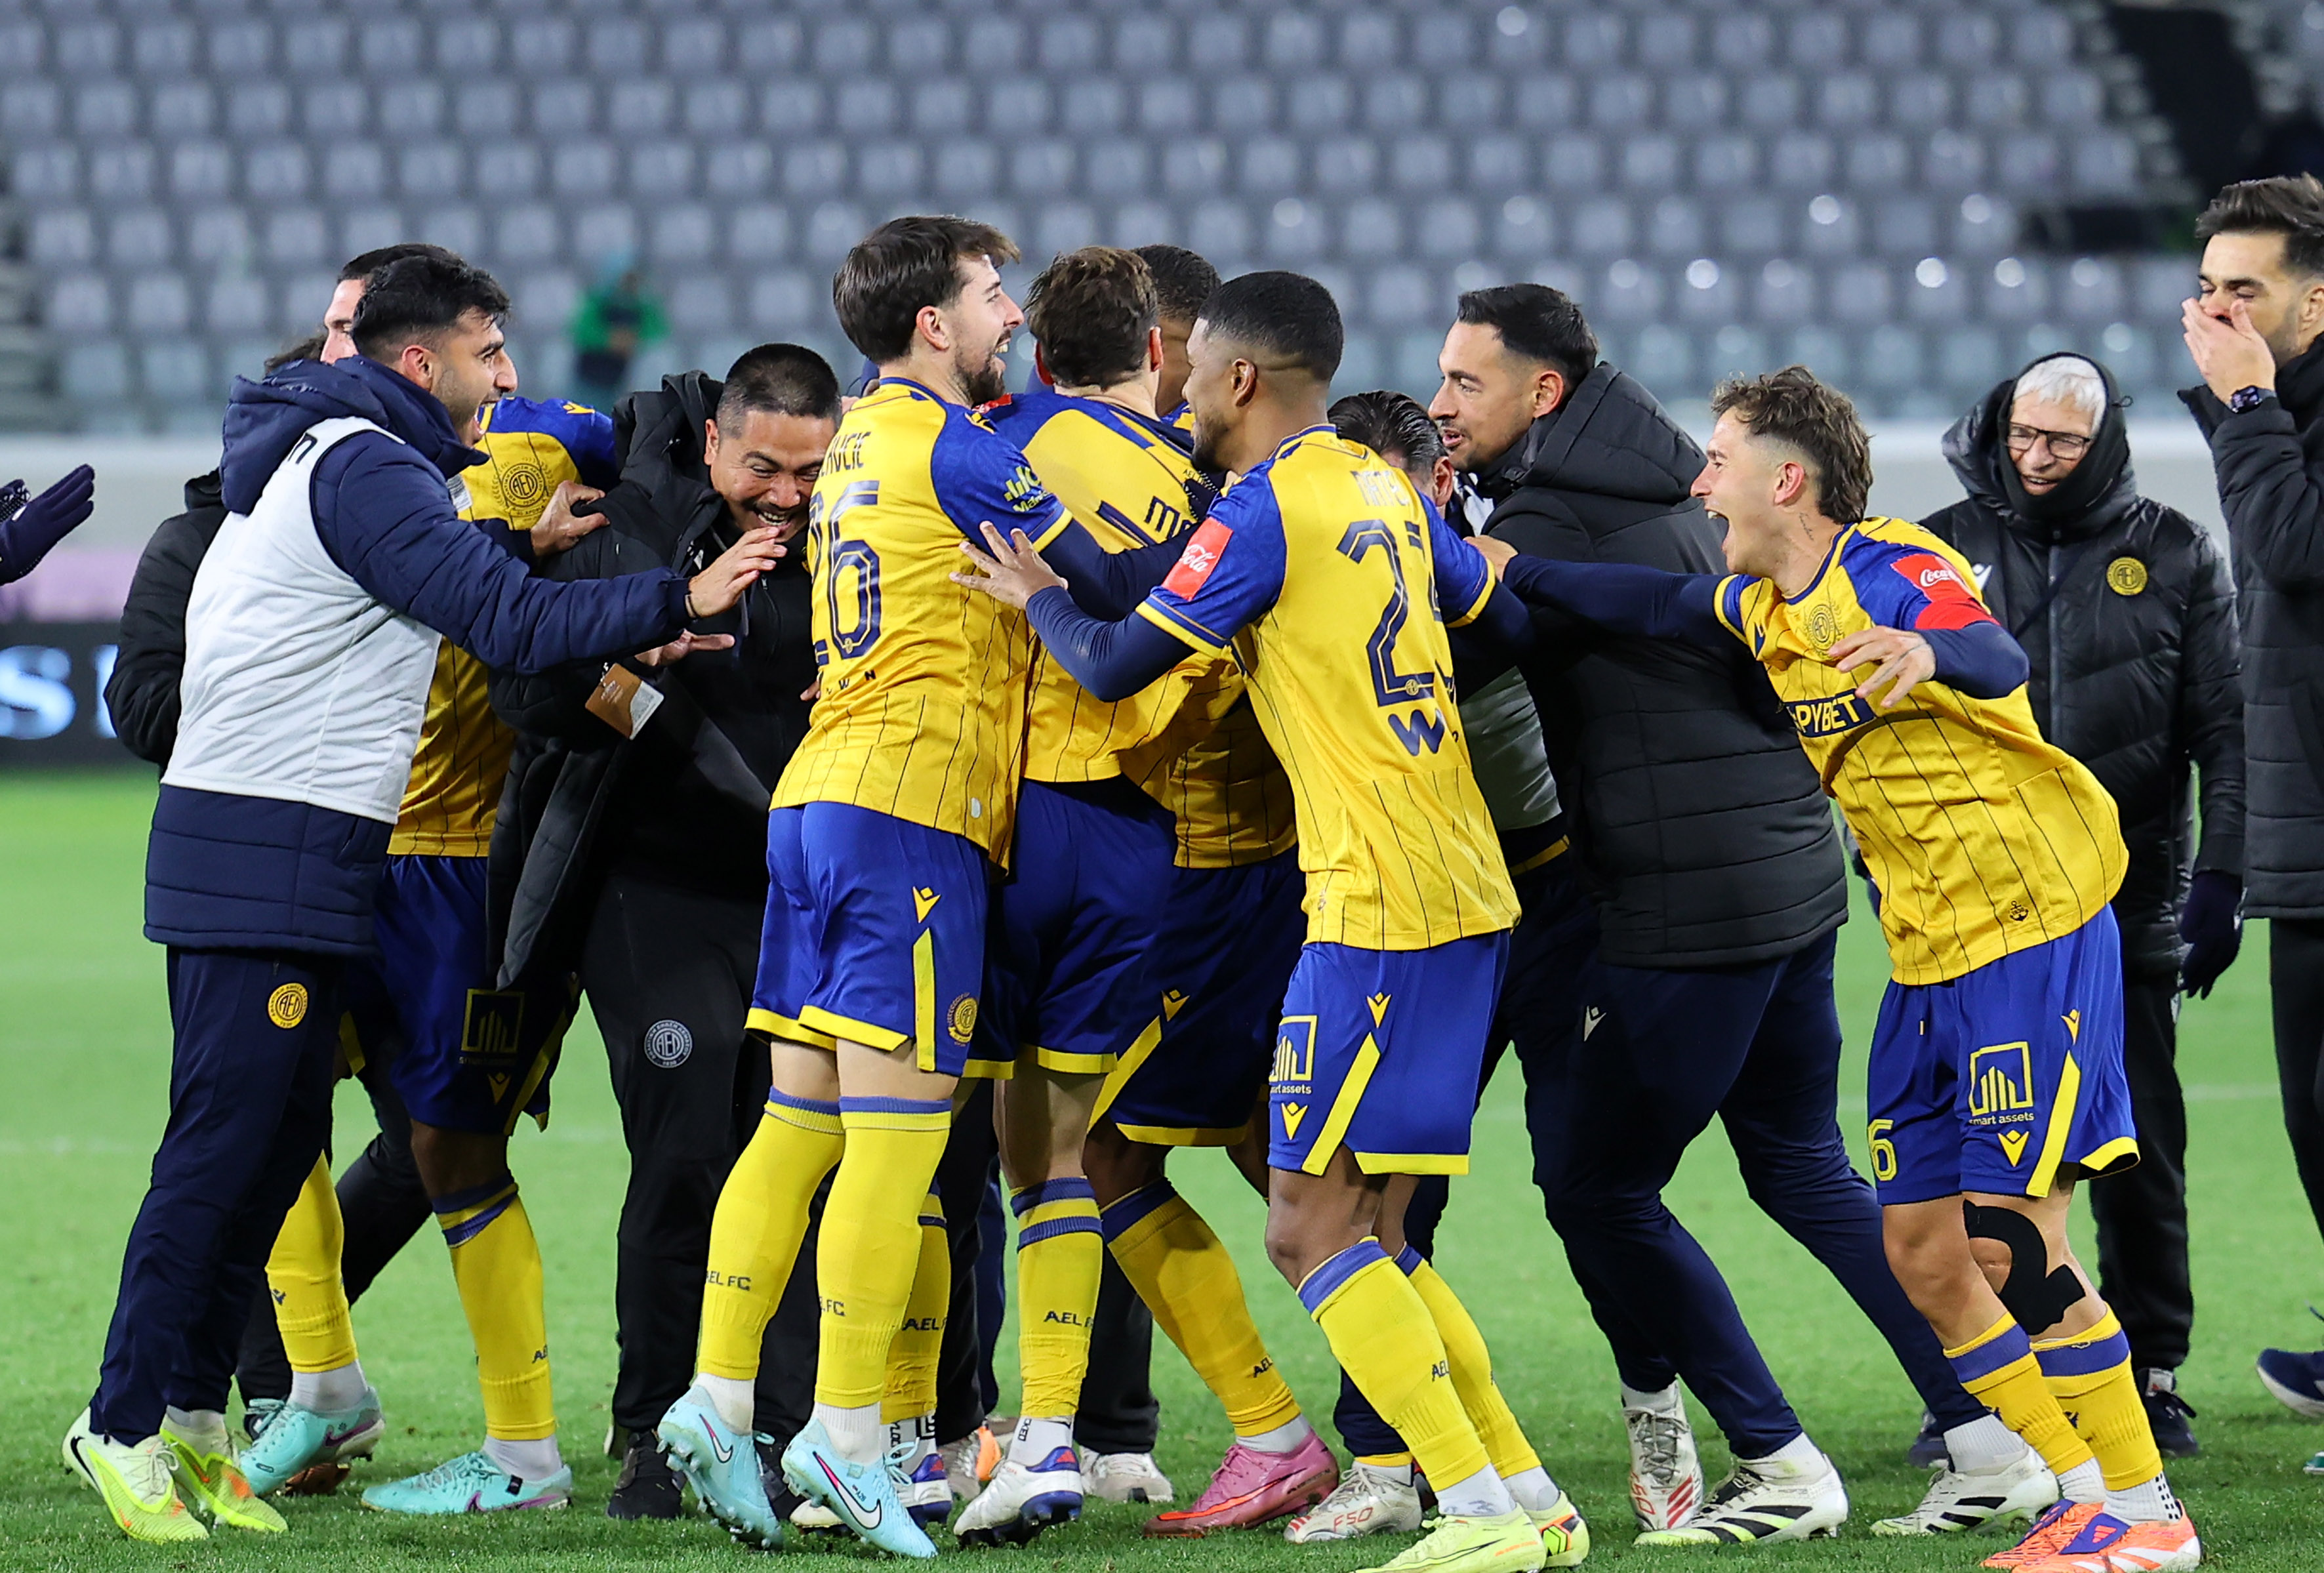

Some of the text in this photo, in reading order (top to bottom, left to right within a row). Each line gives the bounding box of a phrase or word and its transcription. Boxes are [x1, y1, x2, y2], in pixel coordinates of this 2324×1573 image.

[1998, 1111, 2035, 1124] assets
[727, 1275, 752, 1292] FC
[826, 1299, 846, 1317] FC
[901, 1317, 940, 1332] AEL
[1043, 1310, 1082, 1326] AEL
